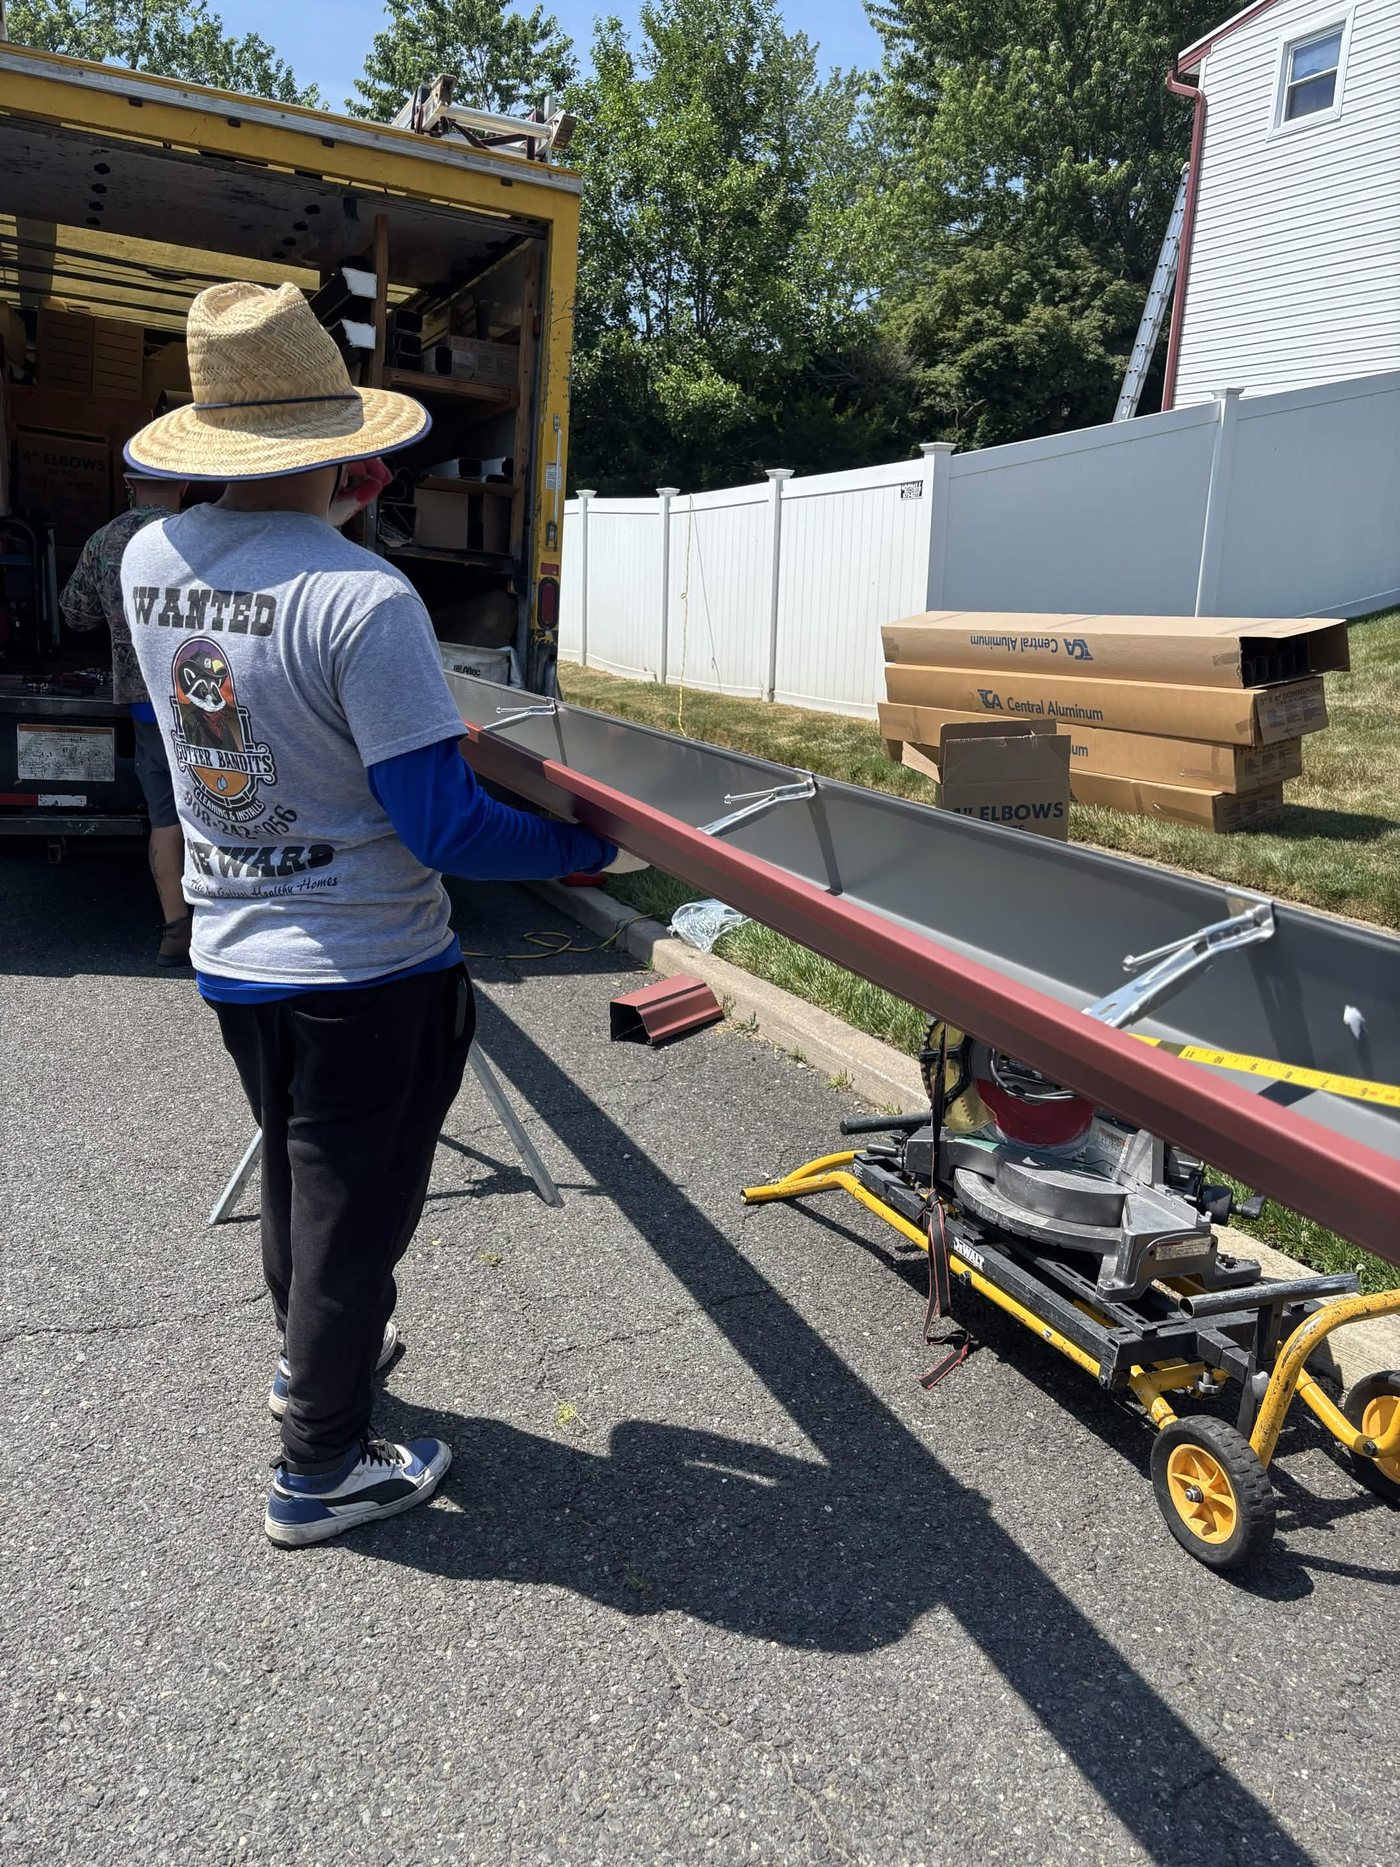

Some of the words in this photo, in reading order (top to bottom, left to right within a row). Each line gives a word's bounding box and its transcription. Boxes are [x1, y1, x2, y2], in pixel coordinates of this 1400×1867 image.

[44, 454, 105, 472] ELBOWS
[132, 586, 277, 637] WANTED
[970, 635, 1017, 652] Aluminum
[1020, 637, 1059, 653] Central
[1007, 697, 1045, 715] Central
[1047, 701, 1104, 721] Aluminum
[175, 742, 213, 767] GUTTER
[216, 750, 272, 774] BANDITS
[194, 789, 228, 820] CLEANING
[229, 812, 235, 821] &
[235, 800, 265, 821] INSTALLS
[980, 802, 1064, 821] ELBOWS
[297, 876, 338, 892] Homes
